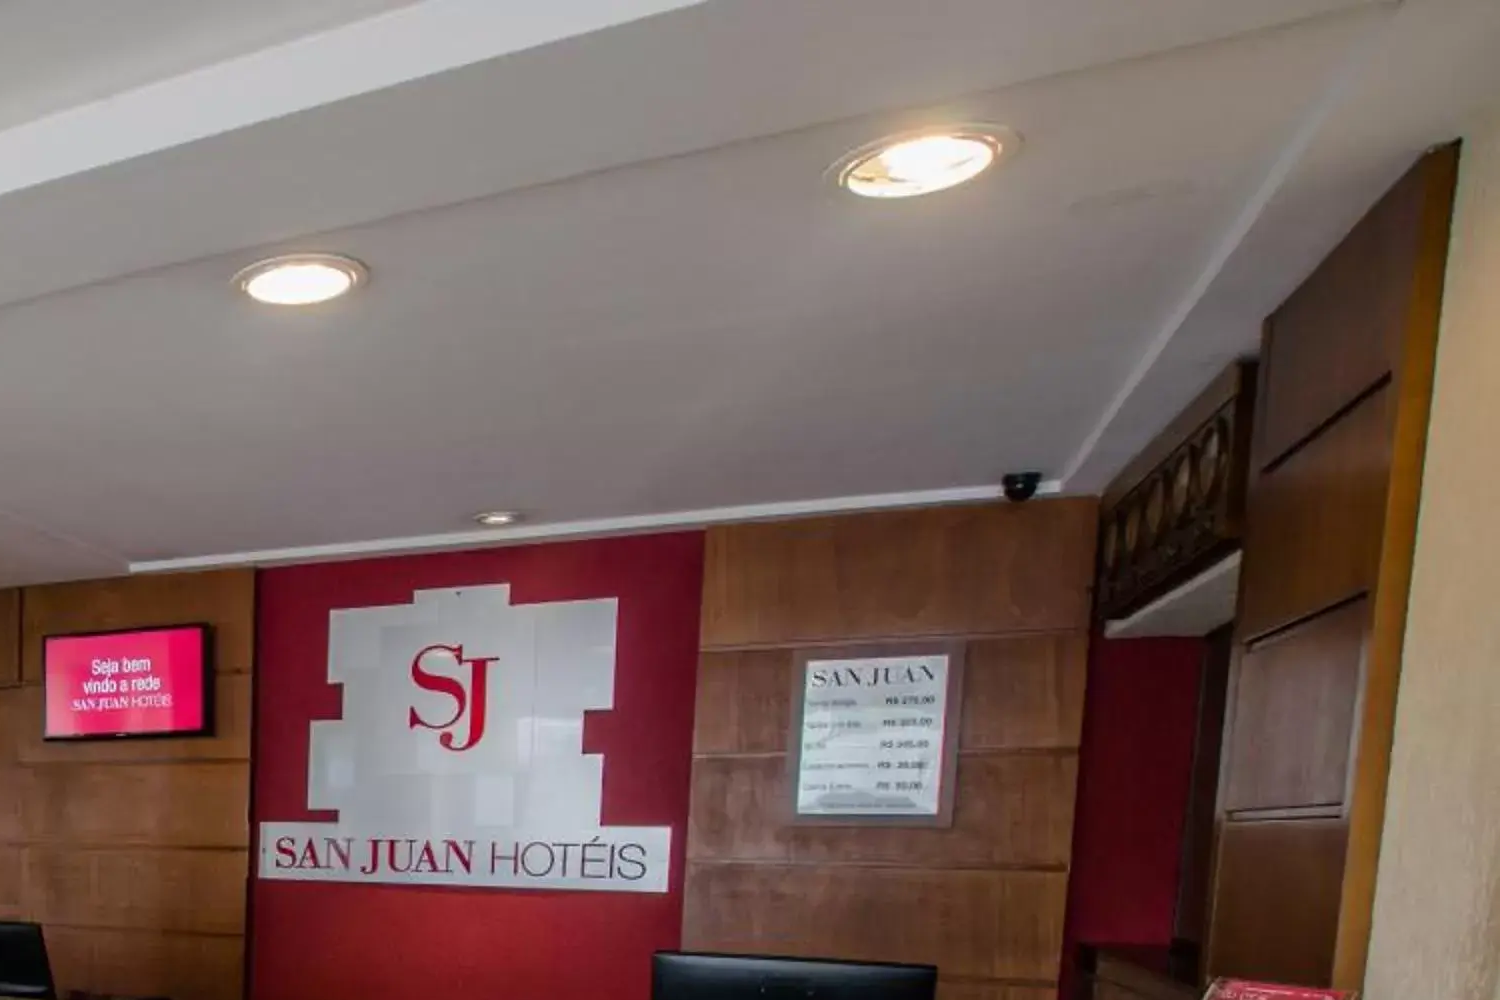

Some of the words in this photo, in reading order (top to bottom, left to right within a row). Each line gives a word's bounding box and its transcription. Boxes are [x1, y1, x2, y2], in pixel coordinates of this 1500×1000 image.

[92, 658, 119, 676] Seja
[122, 656, 152, 673] bem
[811, 666, 863, 688] SAN
[867, 664, 935, 687] JUAN
[83, 677, 117, 695] vindo
[119, 679, 129, 692] a
[131, 675, 161, 691] rede
[72, 697, 96, 711] SAN
[97, 695, 129, 711] JUAN
[409, 643, 500, 752] SJ
[275, 836, 357, 870] SAN
[360, 838, 476, 875] JUAN
[490, 835, 648, 881] HOTÉIS
